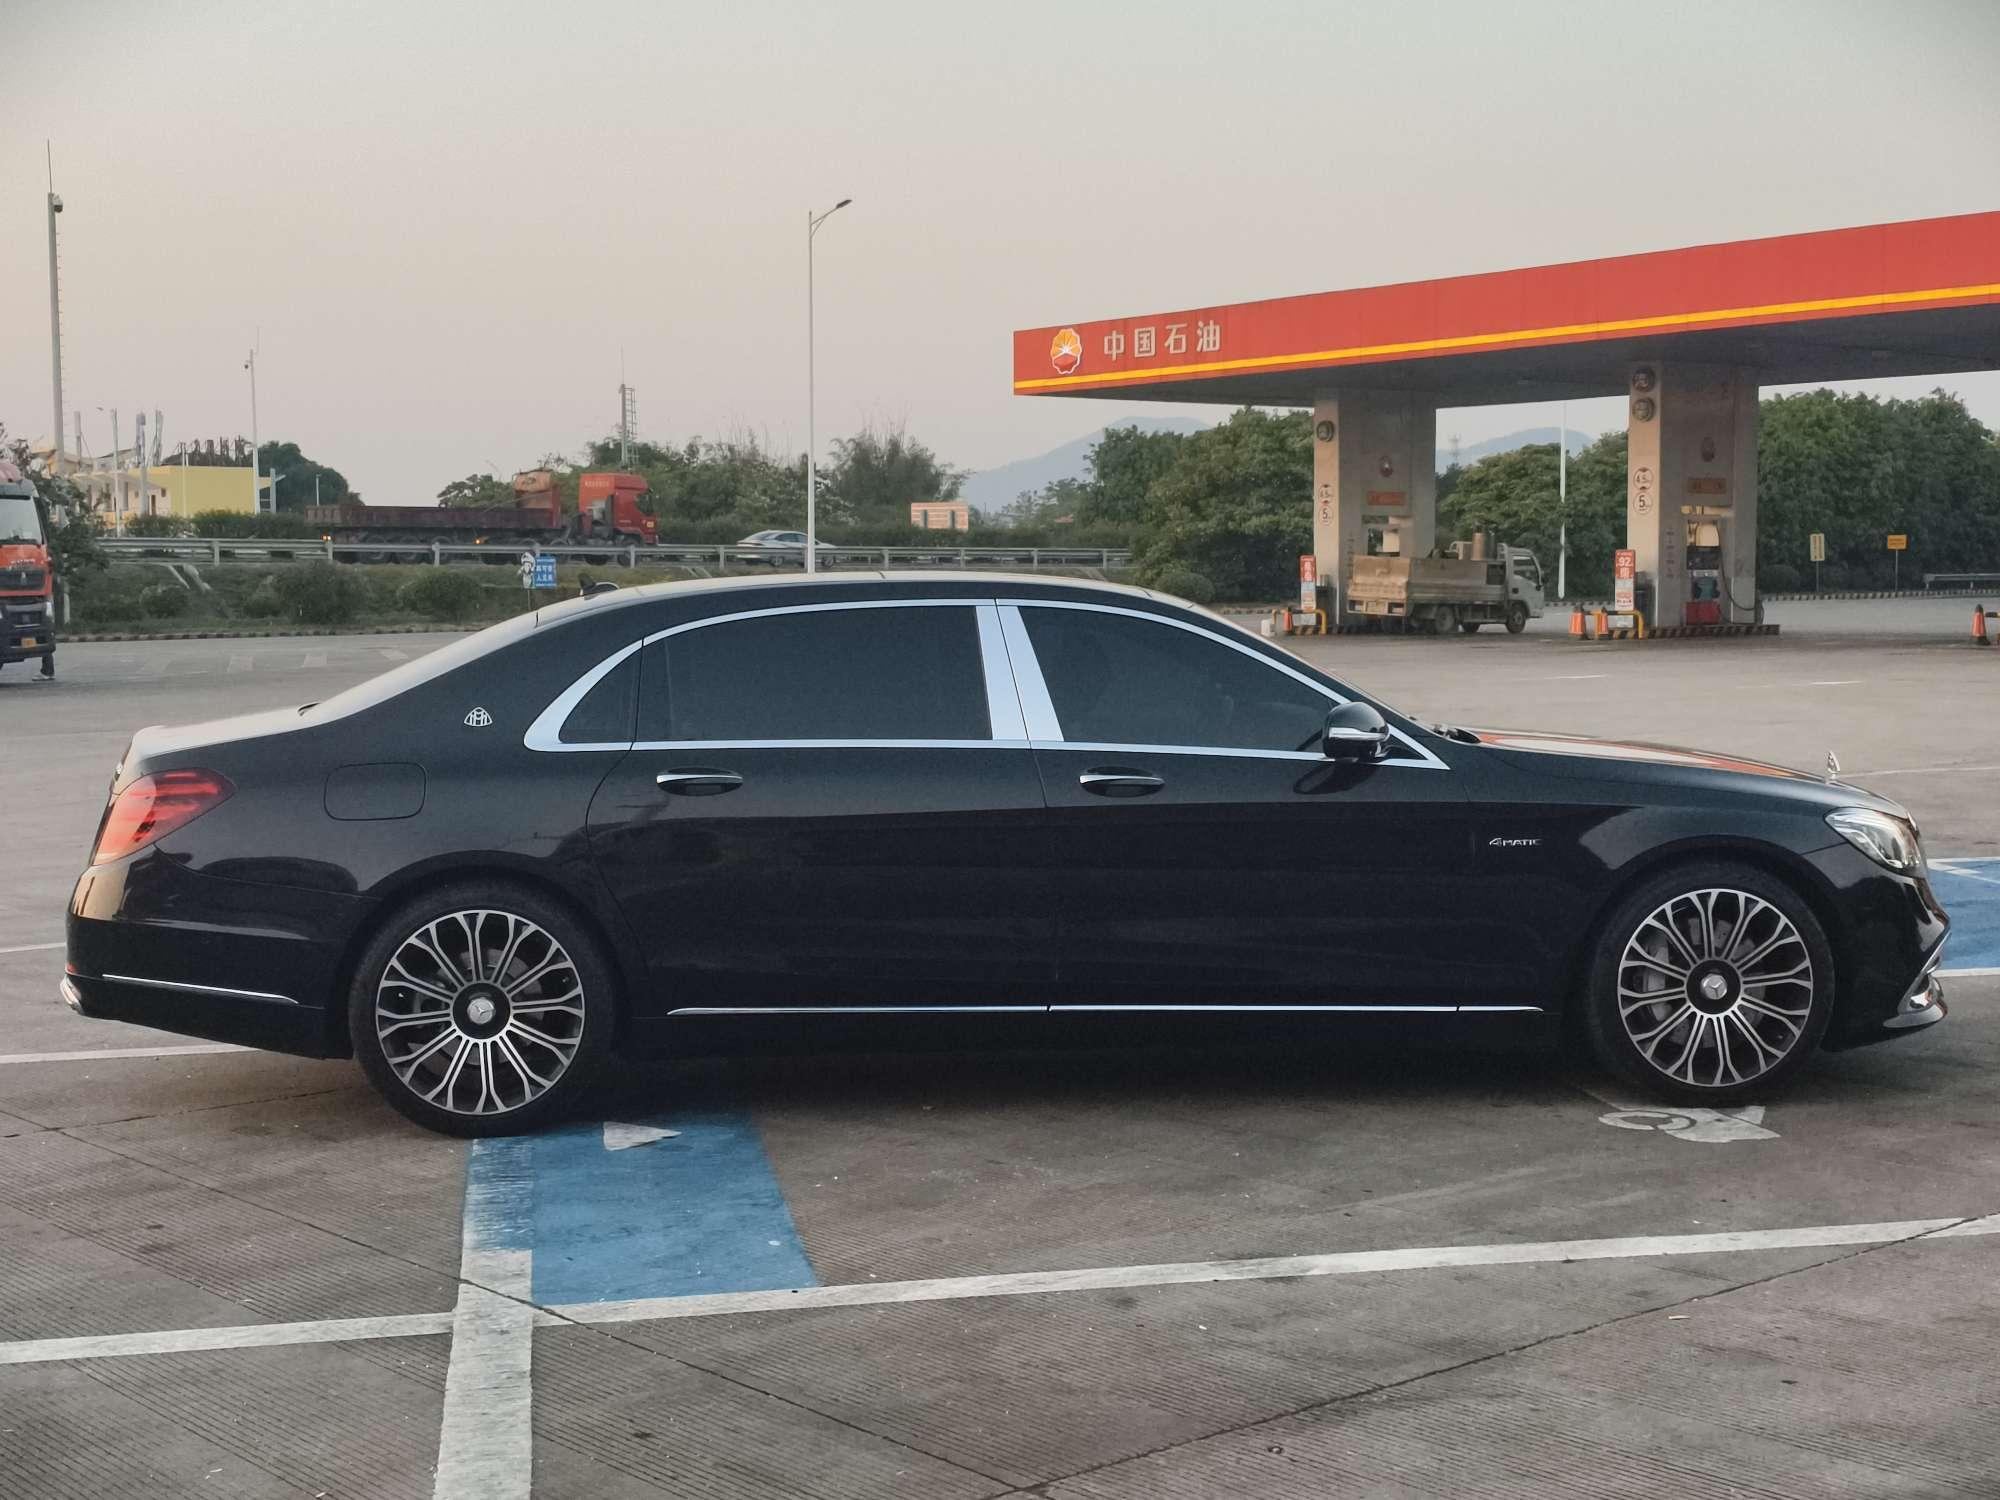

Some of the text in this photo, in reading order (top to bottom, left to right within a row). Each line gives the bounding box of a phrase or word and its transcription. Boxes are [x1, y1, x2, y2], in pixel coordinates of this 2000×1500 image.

[1103, 319, 1221, 362] 中国石油
[1488, 837, 1542, 847] 4MATIC
